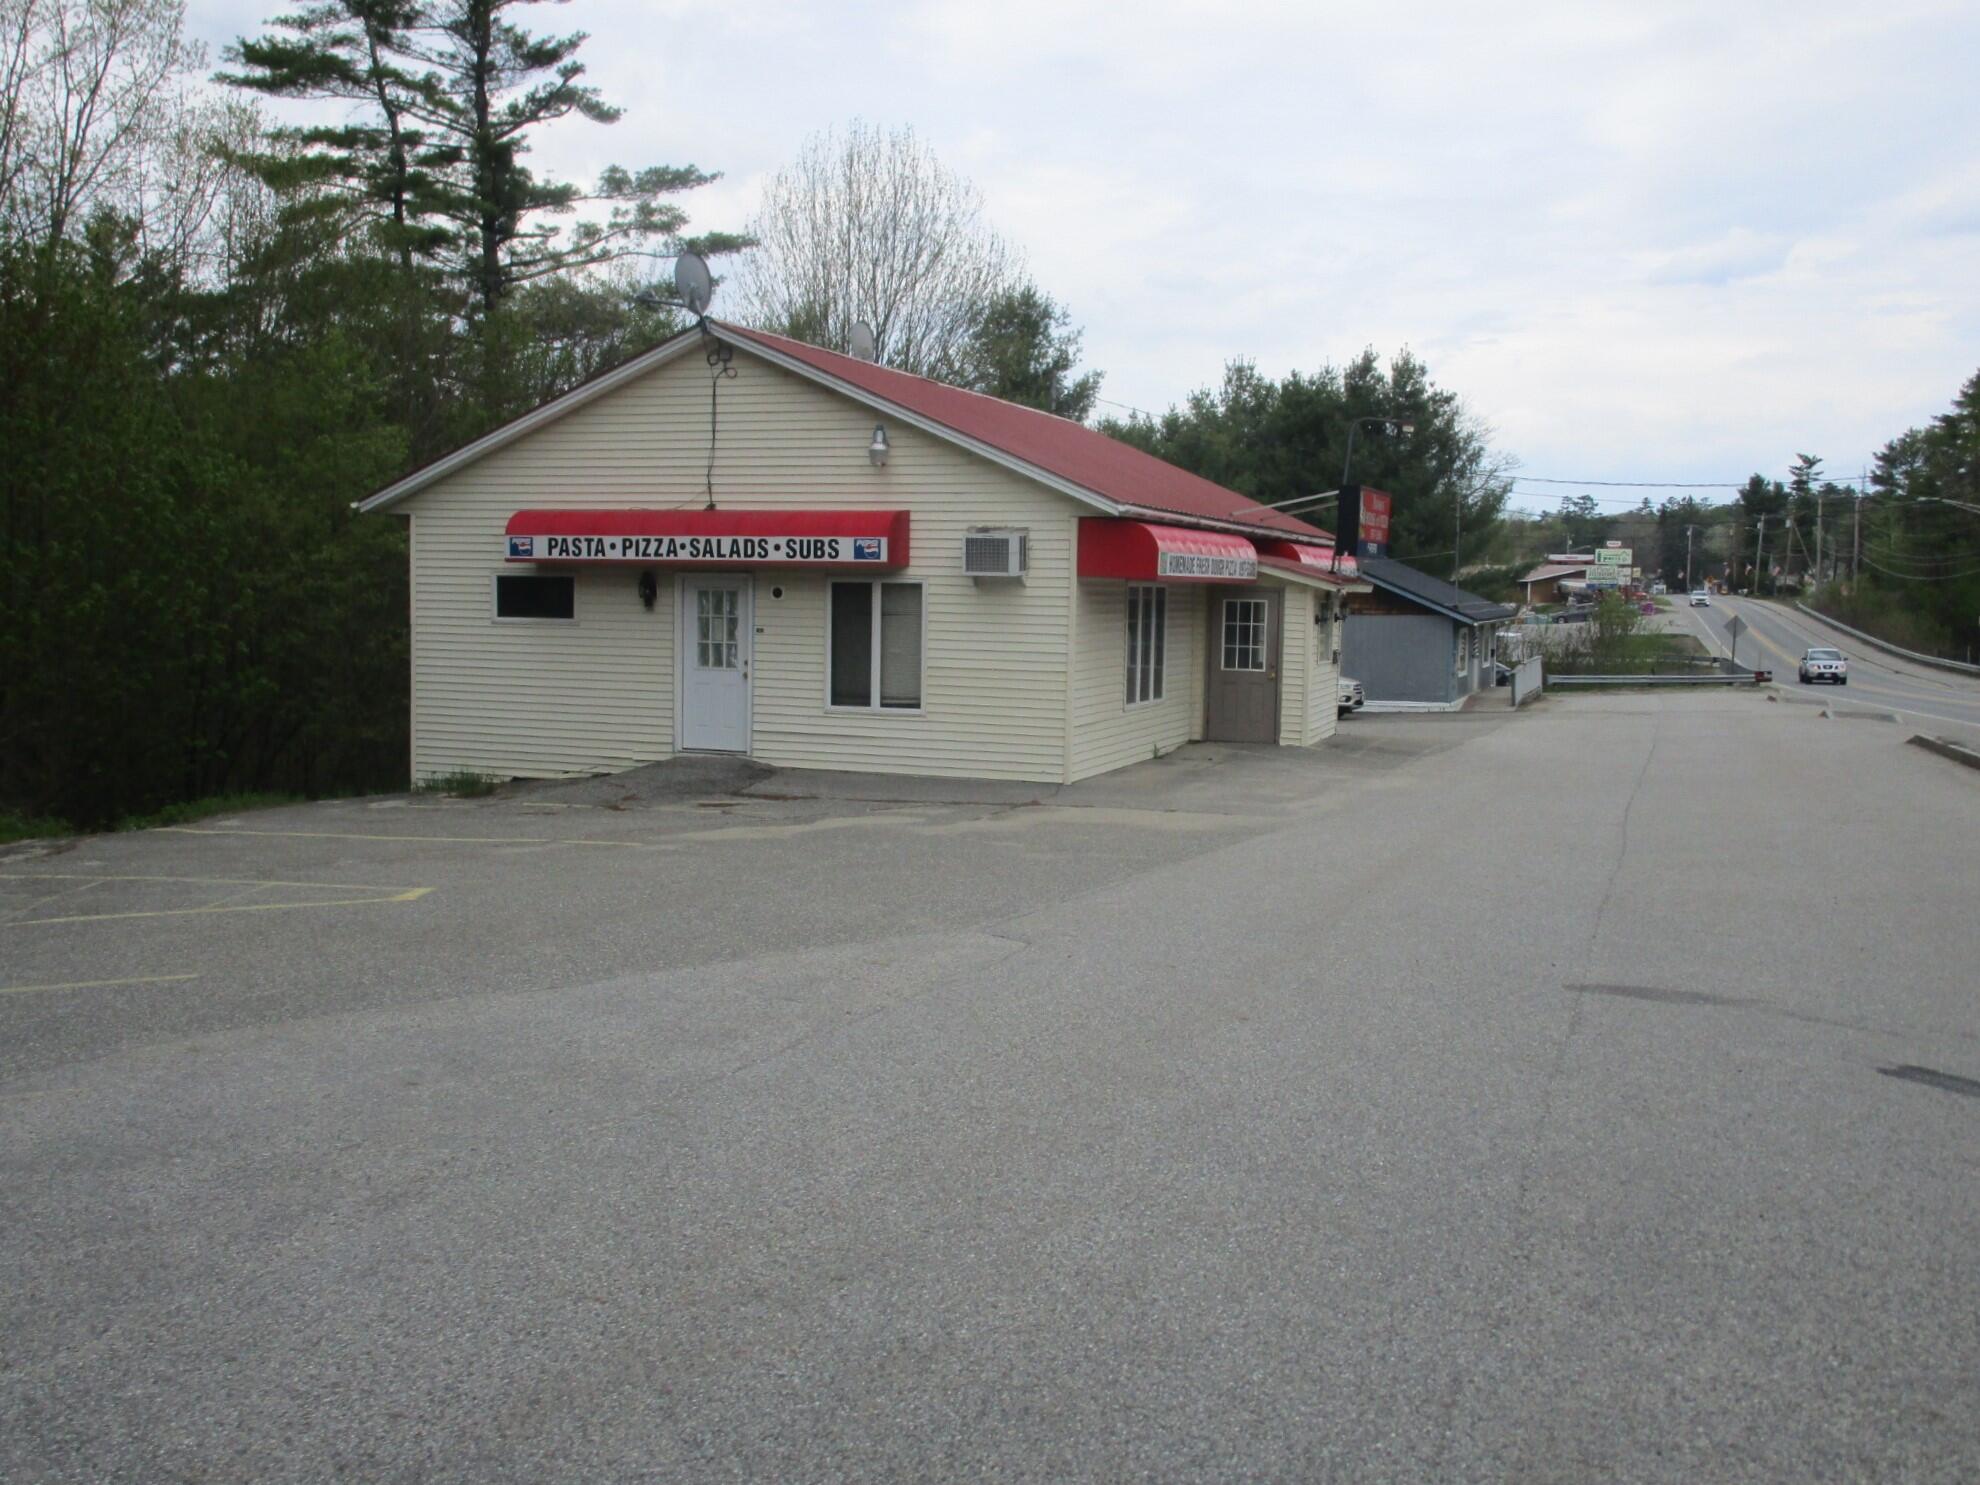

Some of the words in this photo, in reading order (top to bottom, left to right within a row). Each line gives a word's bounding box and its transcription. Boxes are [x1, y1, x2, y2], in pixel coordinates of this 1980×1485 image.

[547, 537, 606, 557] PASTA
[621, 537, 678, 558] PIZZA
[689, 538, 769, 559] SALADS
[785, 538, 840, 560] SUBS
